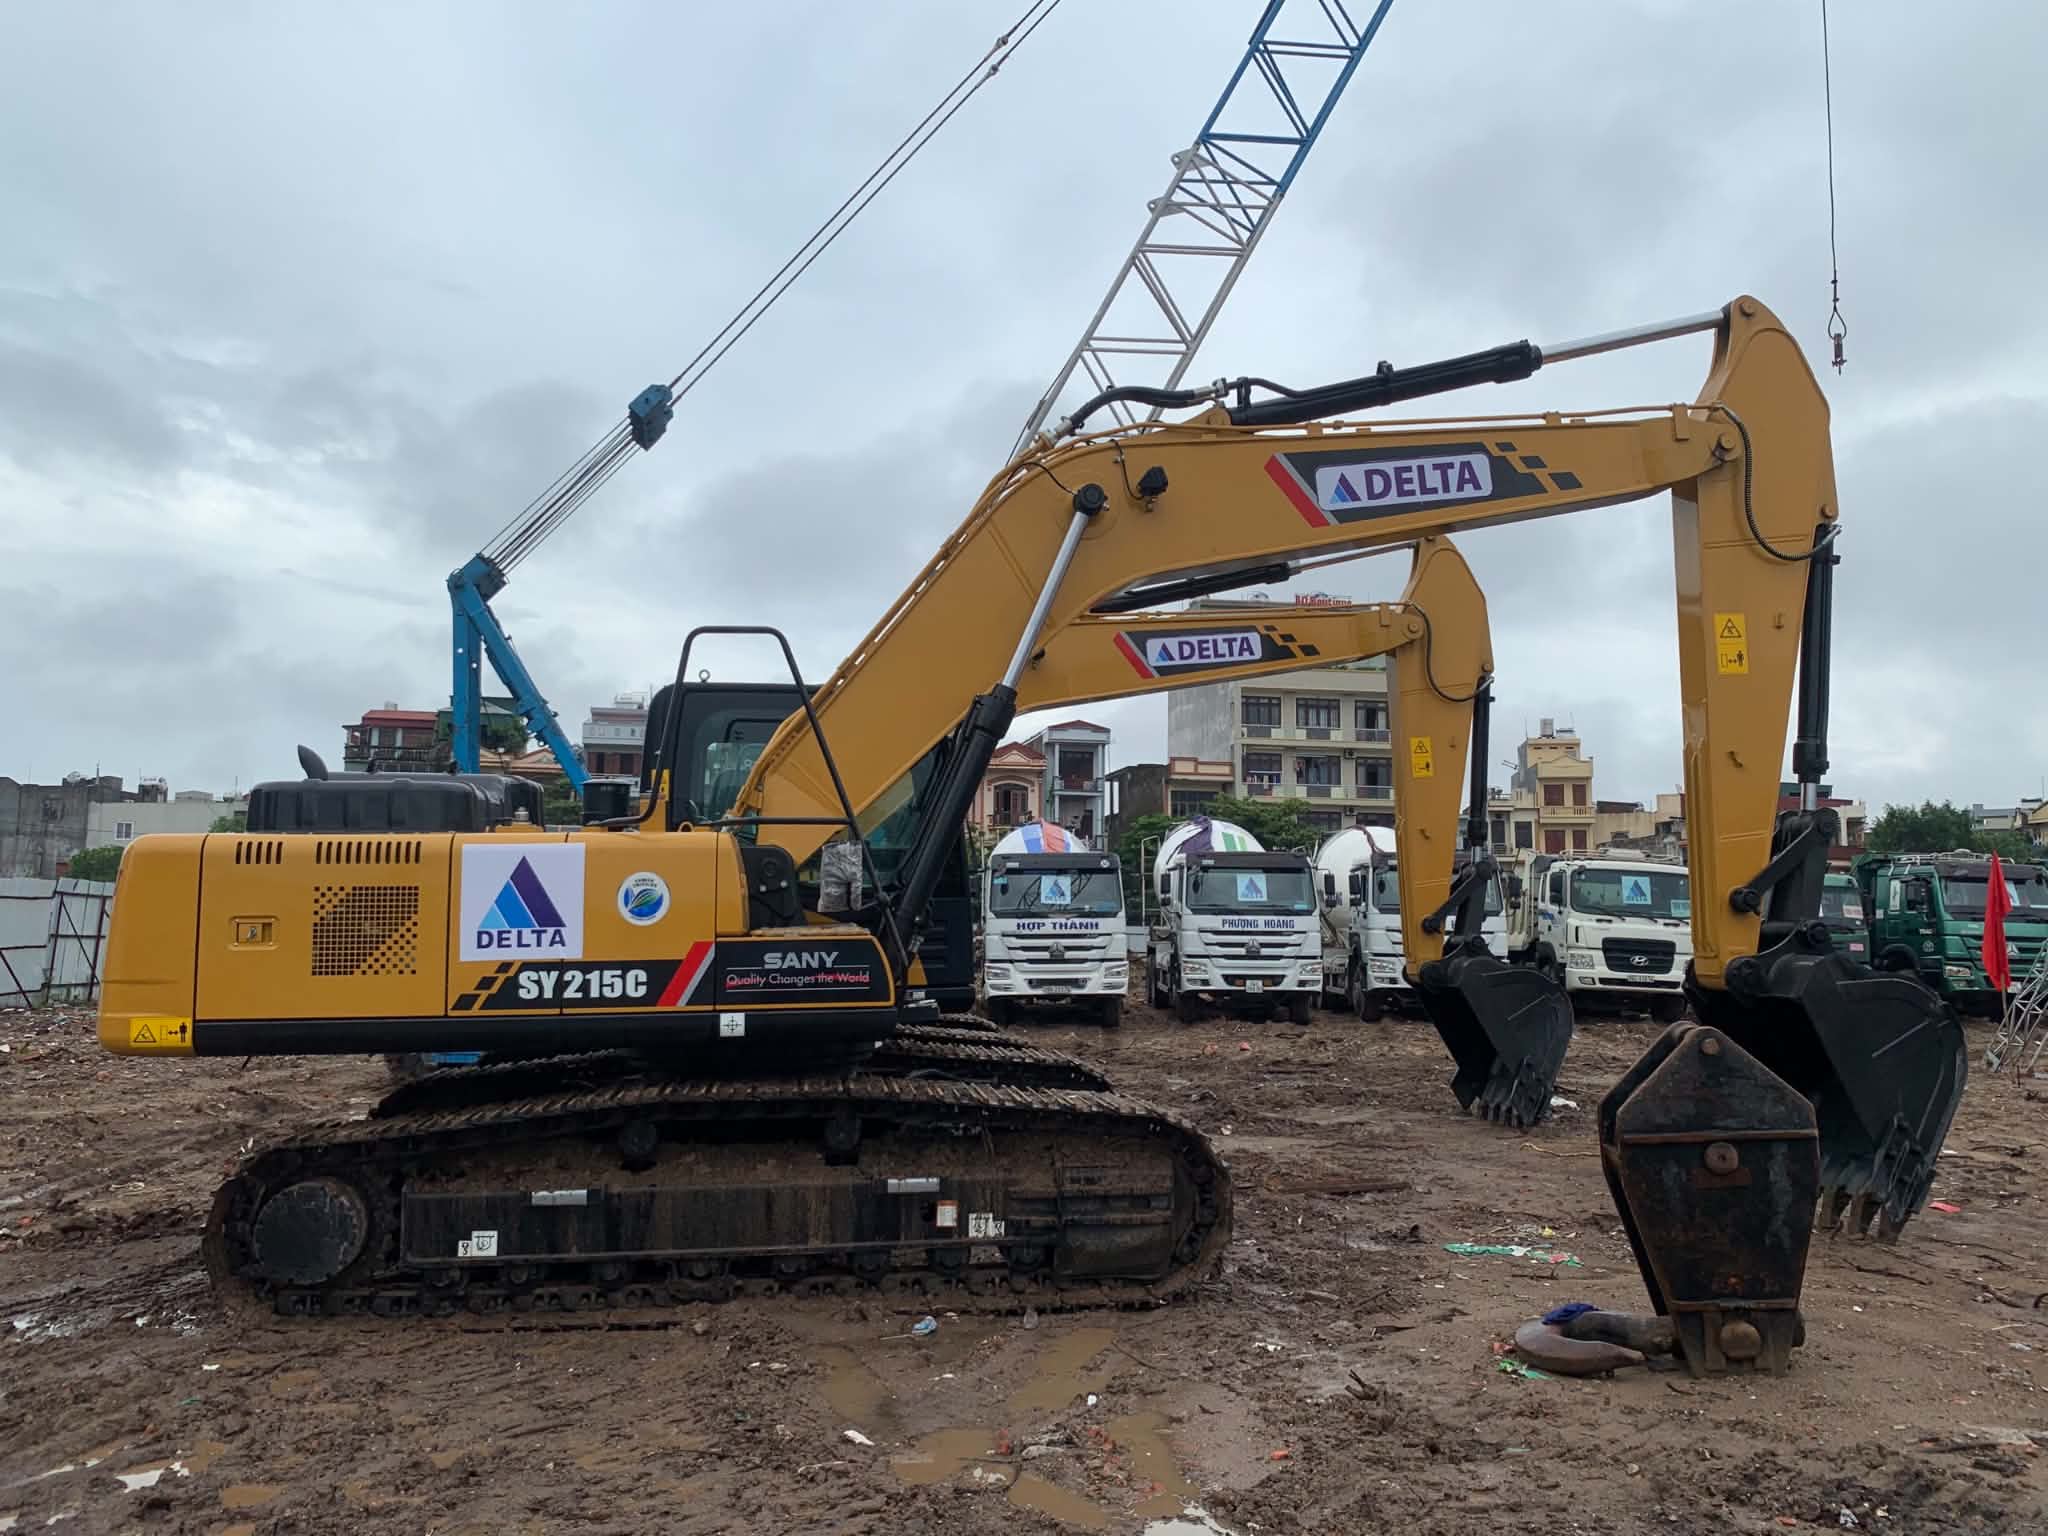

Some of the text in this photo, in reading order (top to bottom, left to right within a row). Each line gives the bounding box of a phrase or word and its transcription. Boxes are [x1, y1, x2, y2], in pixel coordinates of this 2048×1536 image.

[1363, 460, 1483, 501] DELTA
[1177, 636, 1256, 661] DELTA
[475, 928, 568, 950] DELTA
[763, 951, 840, 969] SANY
[517, 968, 649, 999] SY215C
[726, 969, 871, 988] Quality Changes the World
